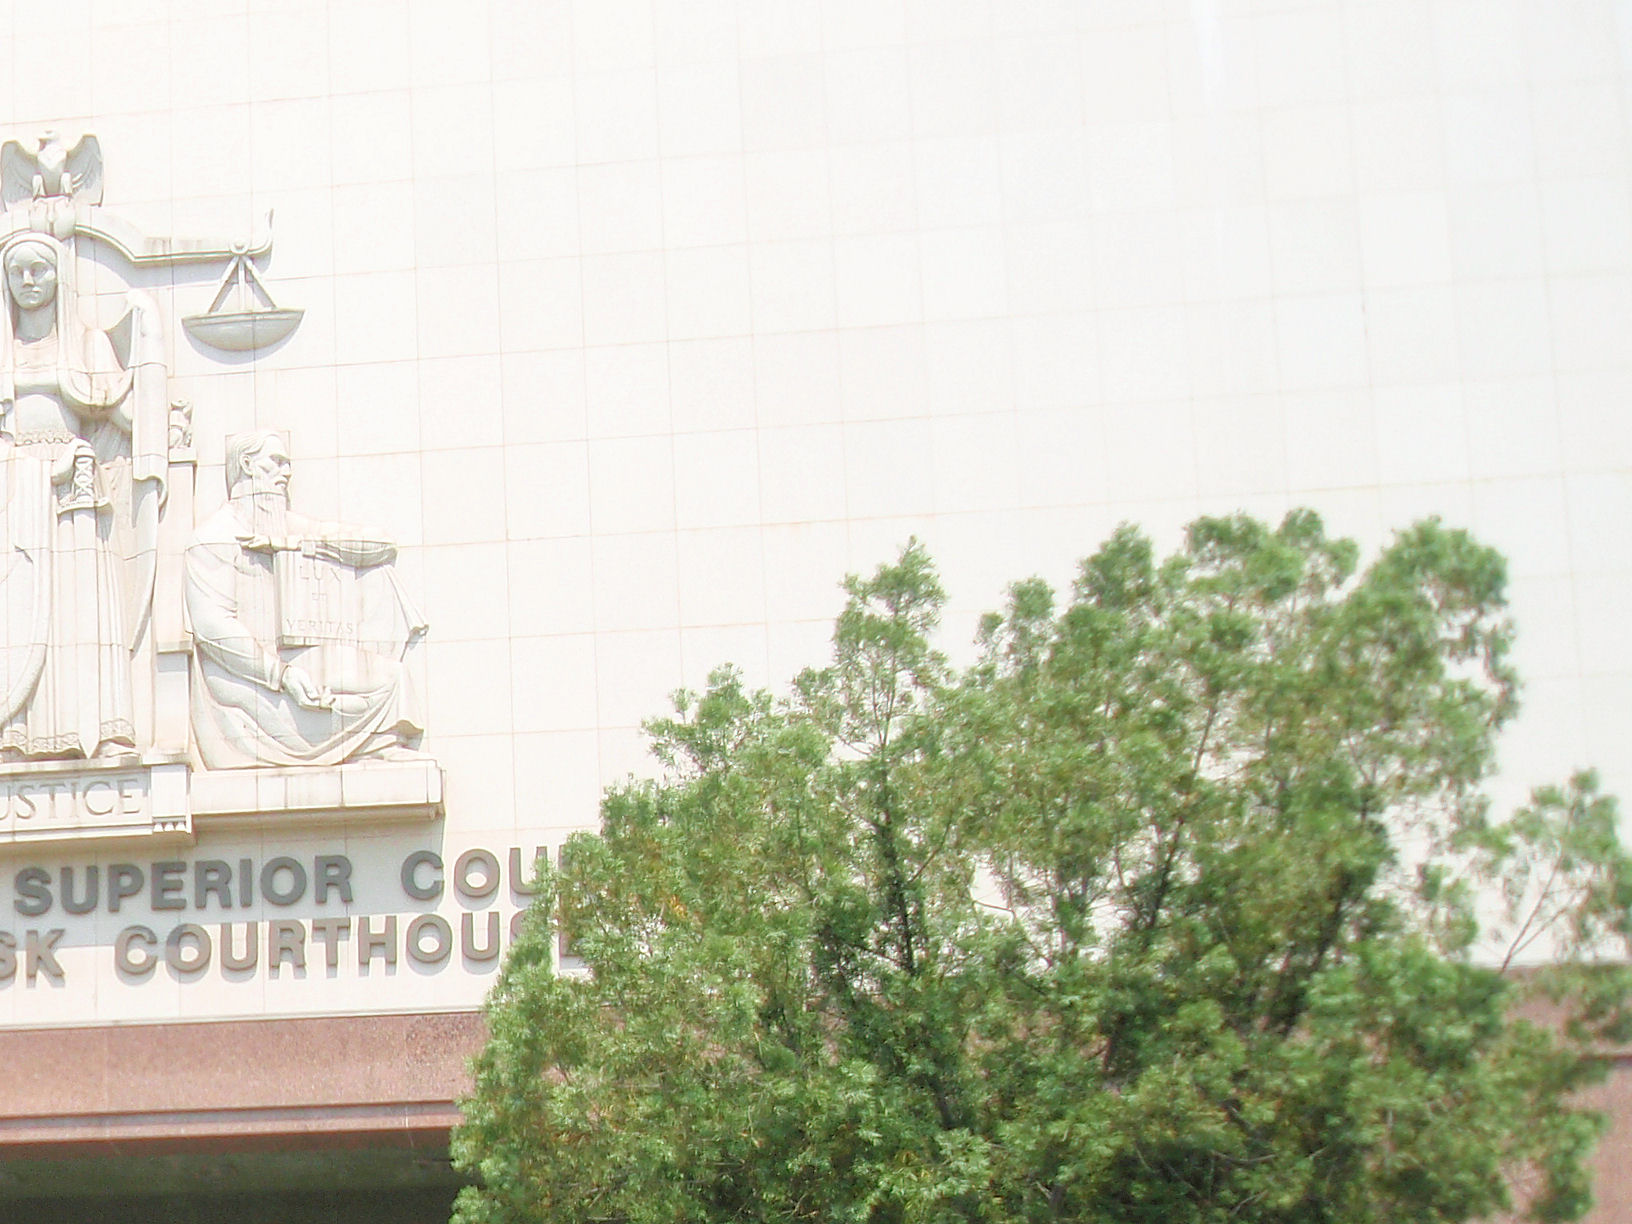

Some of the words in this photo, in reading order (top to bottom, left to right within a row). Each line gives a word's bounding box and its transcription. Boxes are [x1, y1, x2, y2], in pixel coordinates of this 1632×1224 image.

[286, 619, 353, 634] VERITAS
[14, 854, 353, 917] SUPERIOR
[401, 843, 564, 900] COU
[115, 910, 581, 975] COURTHOU
